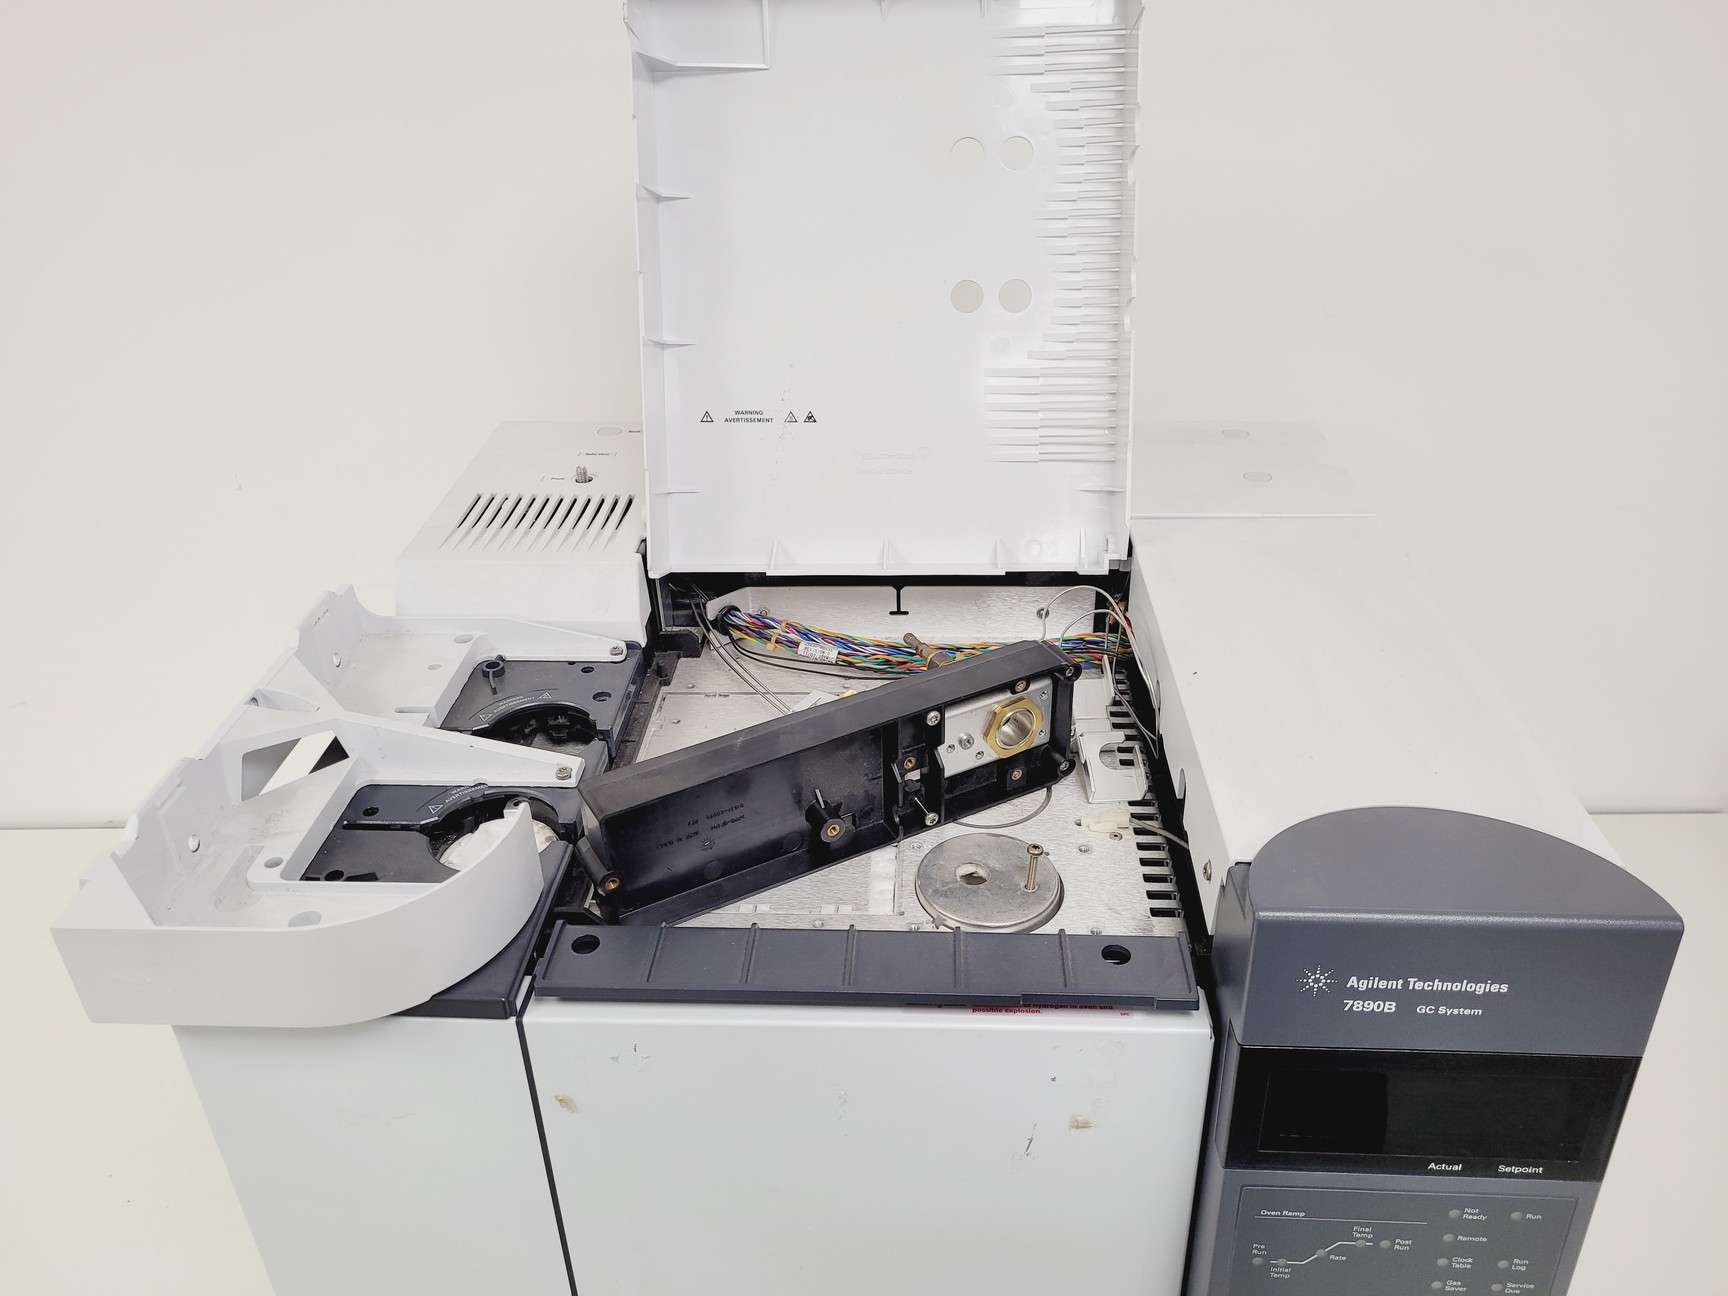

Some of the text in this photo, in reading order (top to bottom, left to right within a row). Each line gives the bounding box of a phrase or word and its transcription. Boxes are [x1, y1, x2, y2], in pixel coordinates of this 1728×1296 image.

[498, 695, 524, 706] WARNING
[1346, 976, 1509, 995] Agilent Technologies
[1343, 1000, 1483, 1016] 7890B GC System
[1427, 1162, 1463, 1171] Actual
[1497, 1164, 1544, 1174] Setpoint
